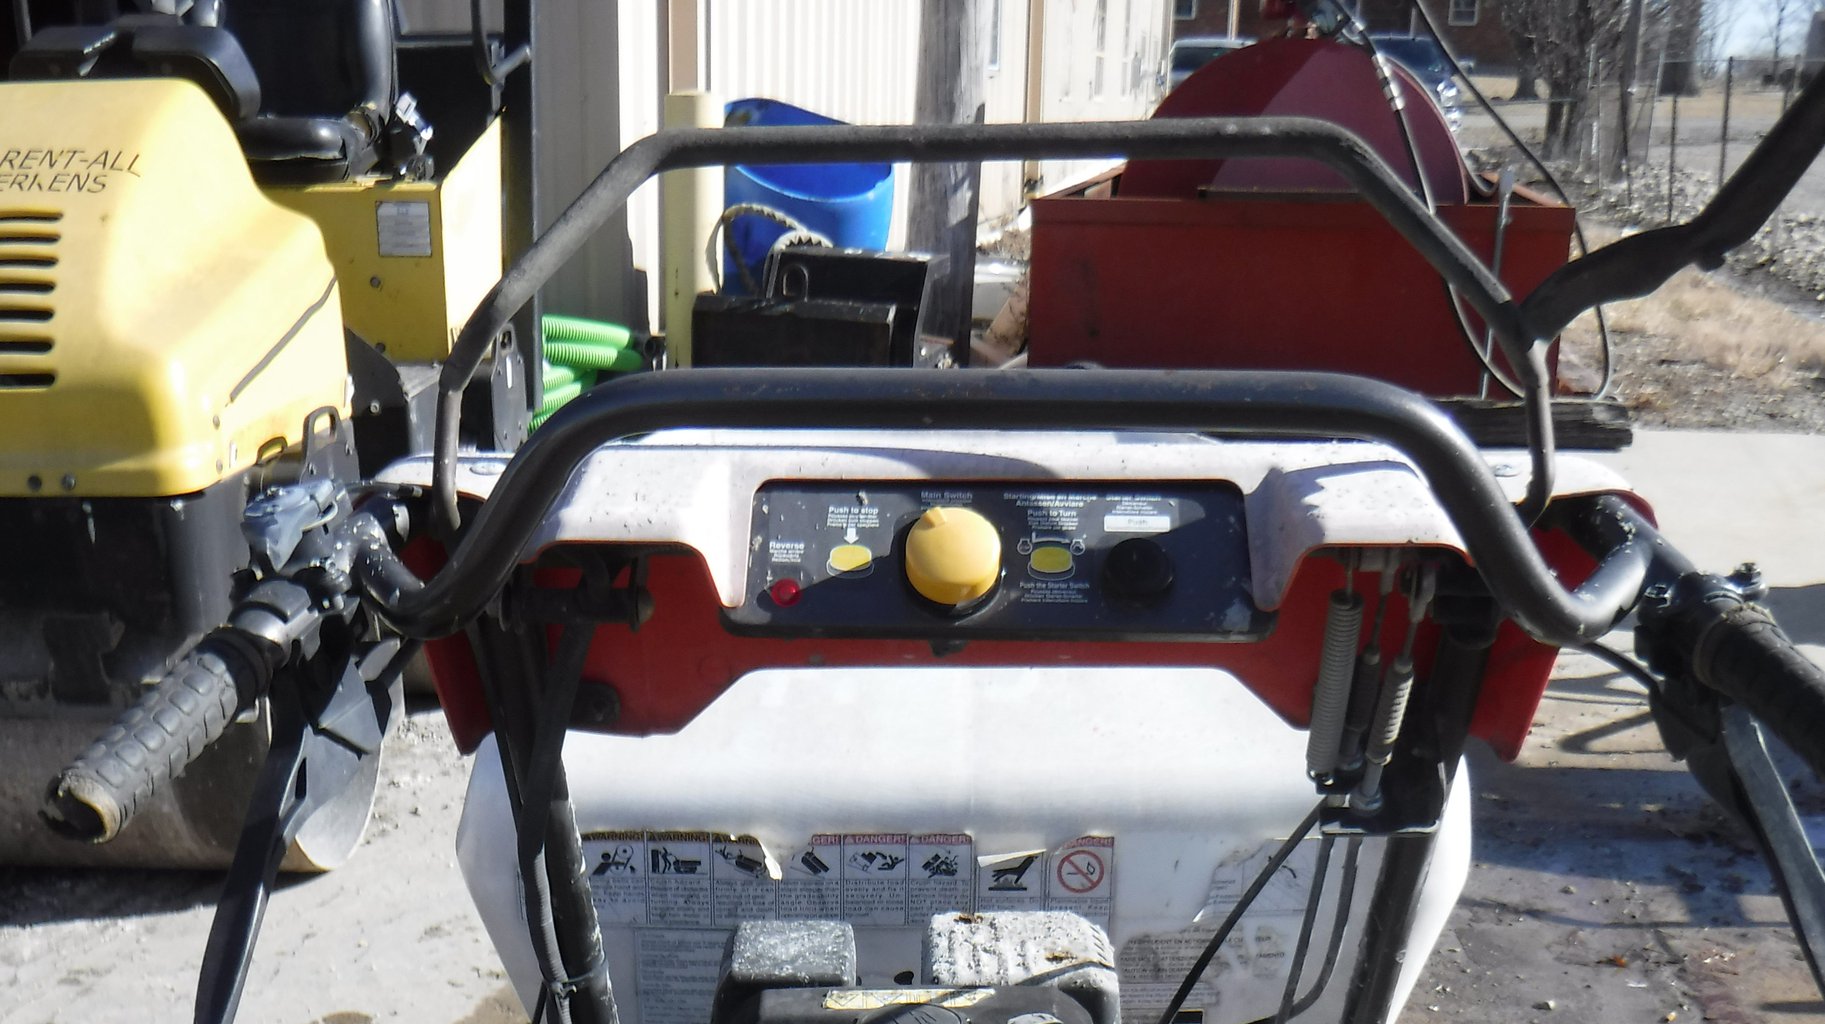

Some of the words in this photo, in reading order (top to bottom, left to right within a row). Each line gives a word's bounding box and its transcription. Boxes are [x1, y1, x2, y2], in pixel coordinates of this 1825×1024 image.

[0, 149, 141, 178] RENT-ALL
[921, 490, 941, 499] Main
[944, 491, 973, 500] Switch
[829, 505, 849, 514] Push
[851, 506, 859, 514] to
[861, 506, 879, 516] stop
[1027, 510, 1049, 518] Push
[1128, 518, 1148, 527] Push
[769, 541, 804, 550] Reverse
[1020, 582, 1035, 590] Push
[1048, 582, 1069, 590] Starter
[1070, 582, 1090, 590] Switch
[855, 835, 906, 845] DANGER!
[921, 836, 970, 845] DANGER!
